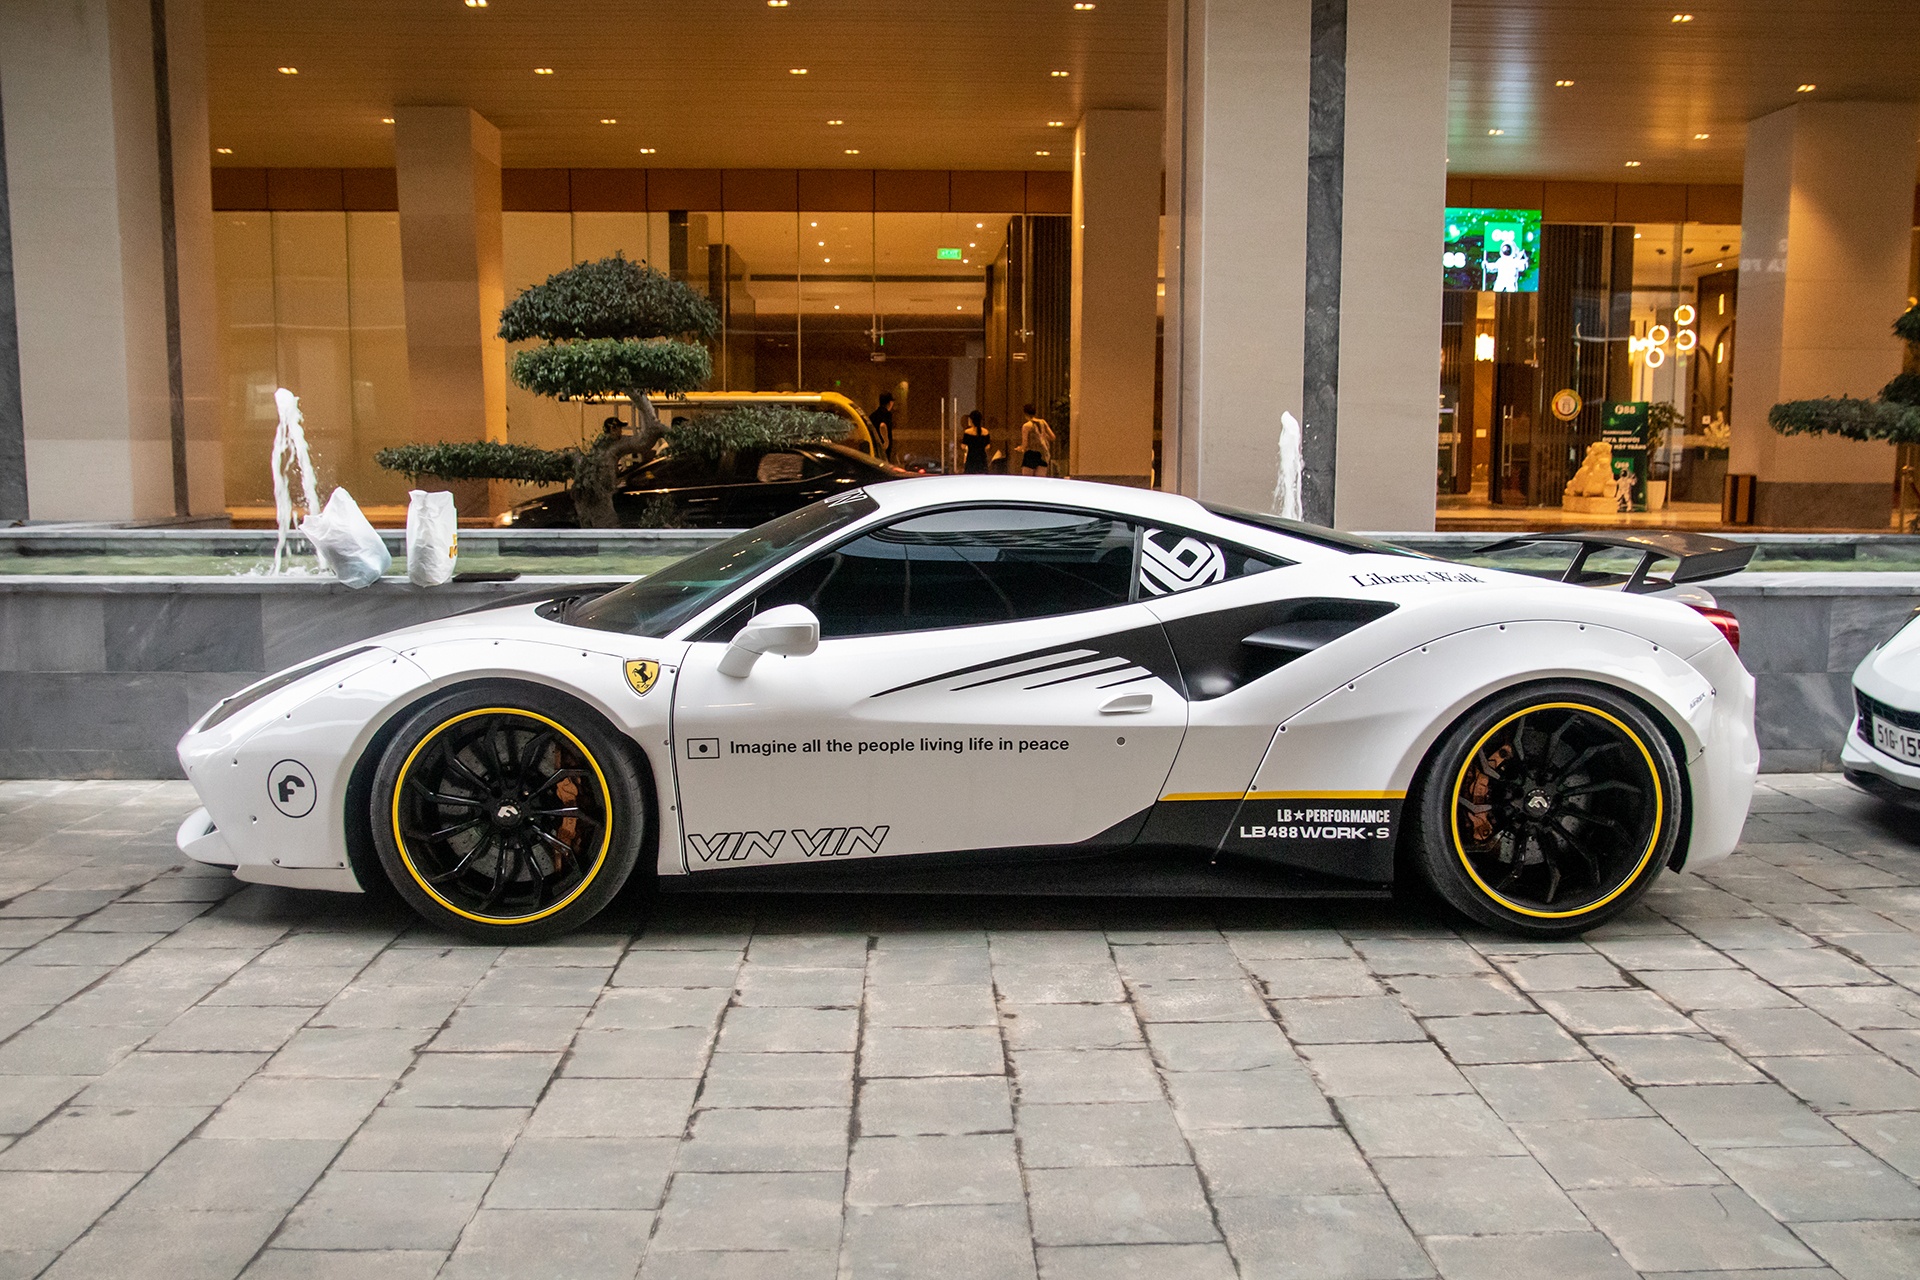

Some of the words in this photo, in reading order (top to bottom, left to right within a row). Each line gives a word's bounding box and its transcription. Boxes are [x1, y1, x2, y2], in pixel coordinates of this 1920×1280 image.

[1349, 572, 1430, 587] Liberty
[1425, 571, 1487, 583] Walk
[730, 740, 797, 756] Imagine
[802, 739, 821, 753] all
[826, 739, 853, 752] the
[858, 738, 915, 754] people
[920, 738, 963, 754] living
[969, 737, 993, 751] life
[999, 737, 1013, 751] in
[1019, 740, 1069, 753] peace
[1877, 723, 1920, 758] 51G-15
[688, 830, 786, 862] VIN
[791, 826, 890, 857] VIN
